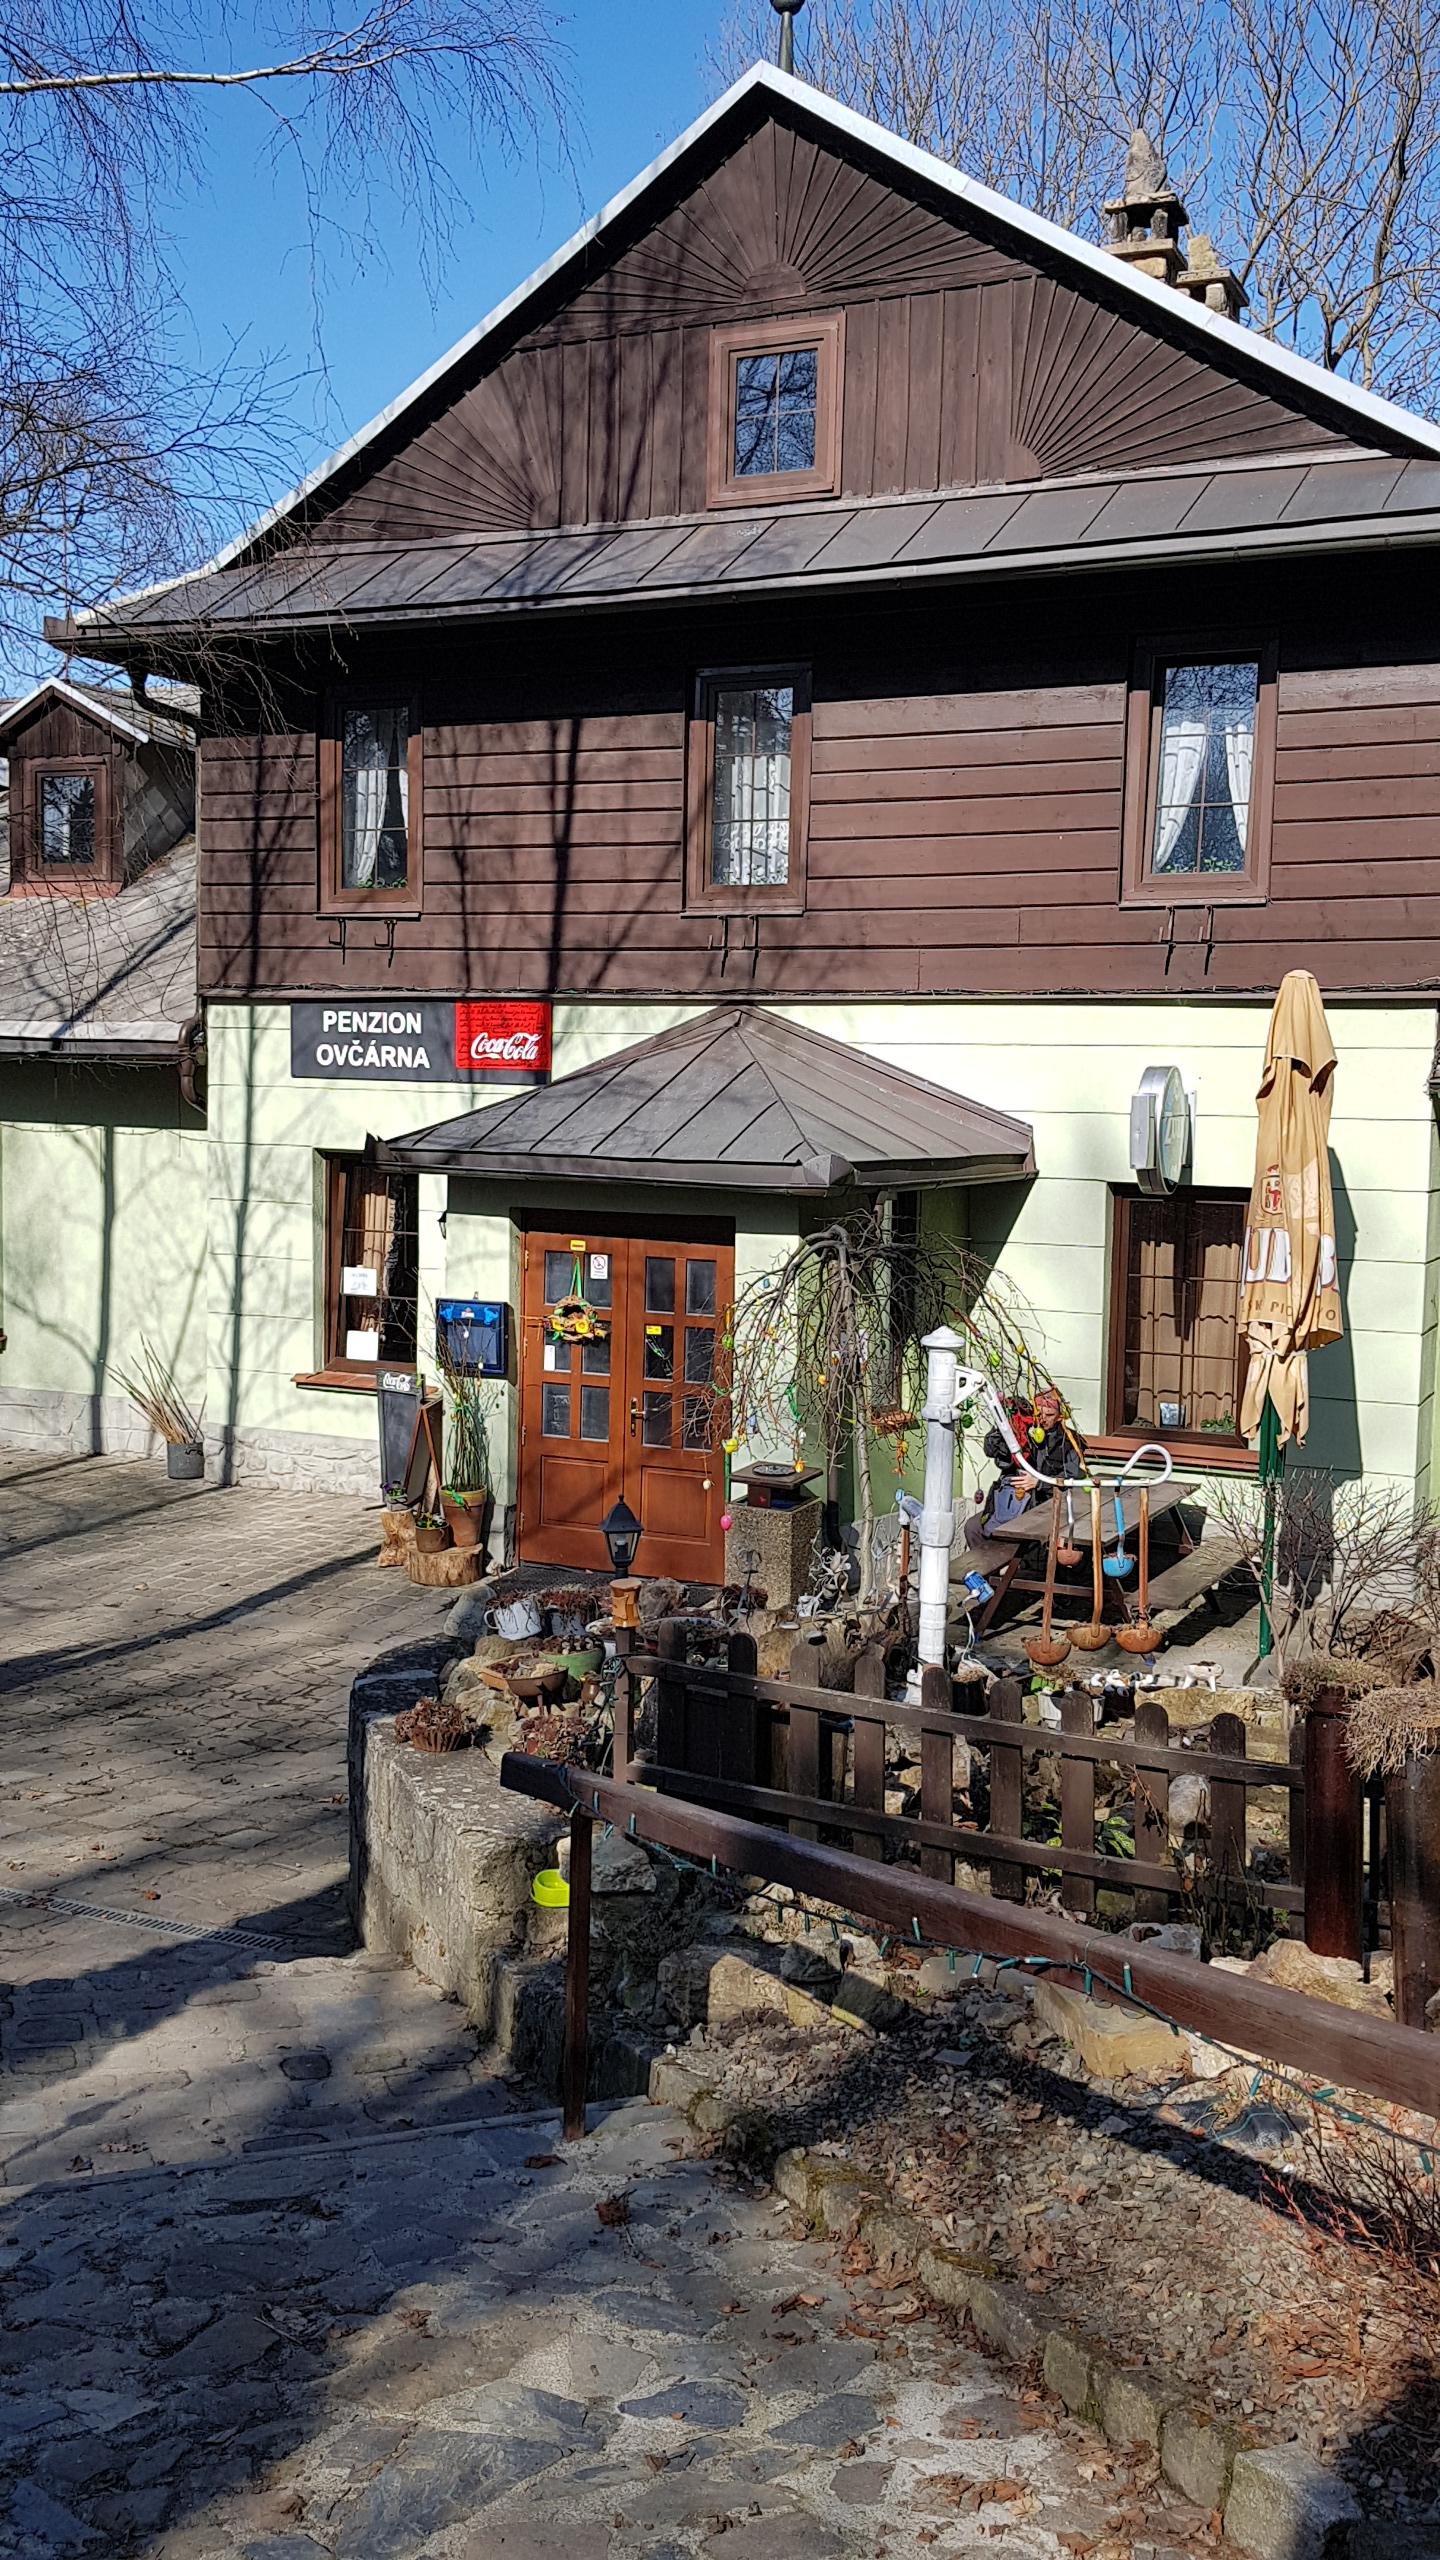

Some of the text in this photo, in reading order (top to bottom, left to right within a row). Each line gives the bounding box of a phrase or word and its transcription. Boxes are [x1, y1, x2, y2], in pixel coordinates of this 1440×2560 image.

[322, 1010, 422, 1034] PENZION
[316, 1040, 431, 1069] OVČÁRNA
[471, 1032, 543, 1060] Coca-Cola
